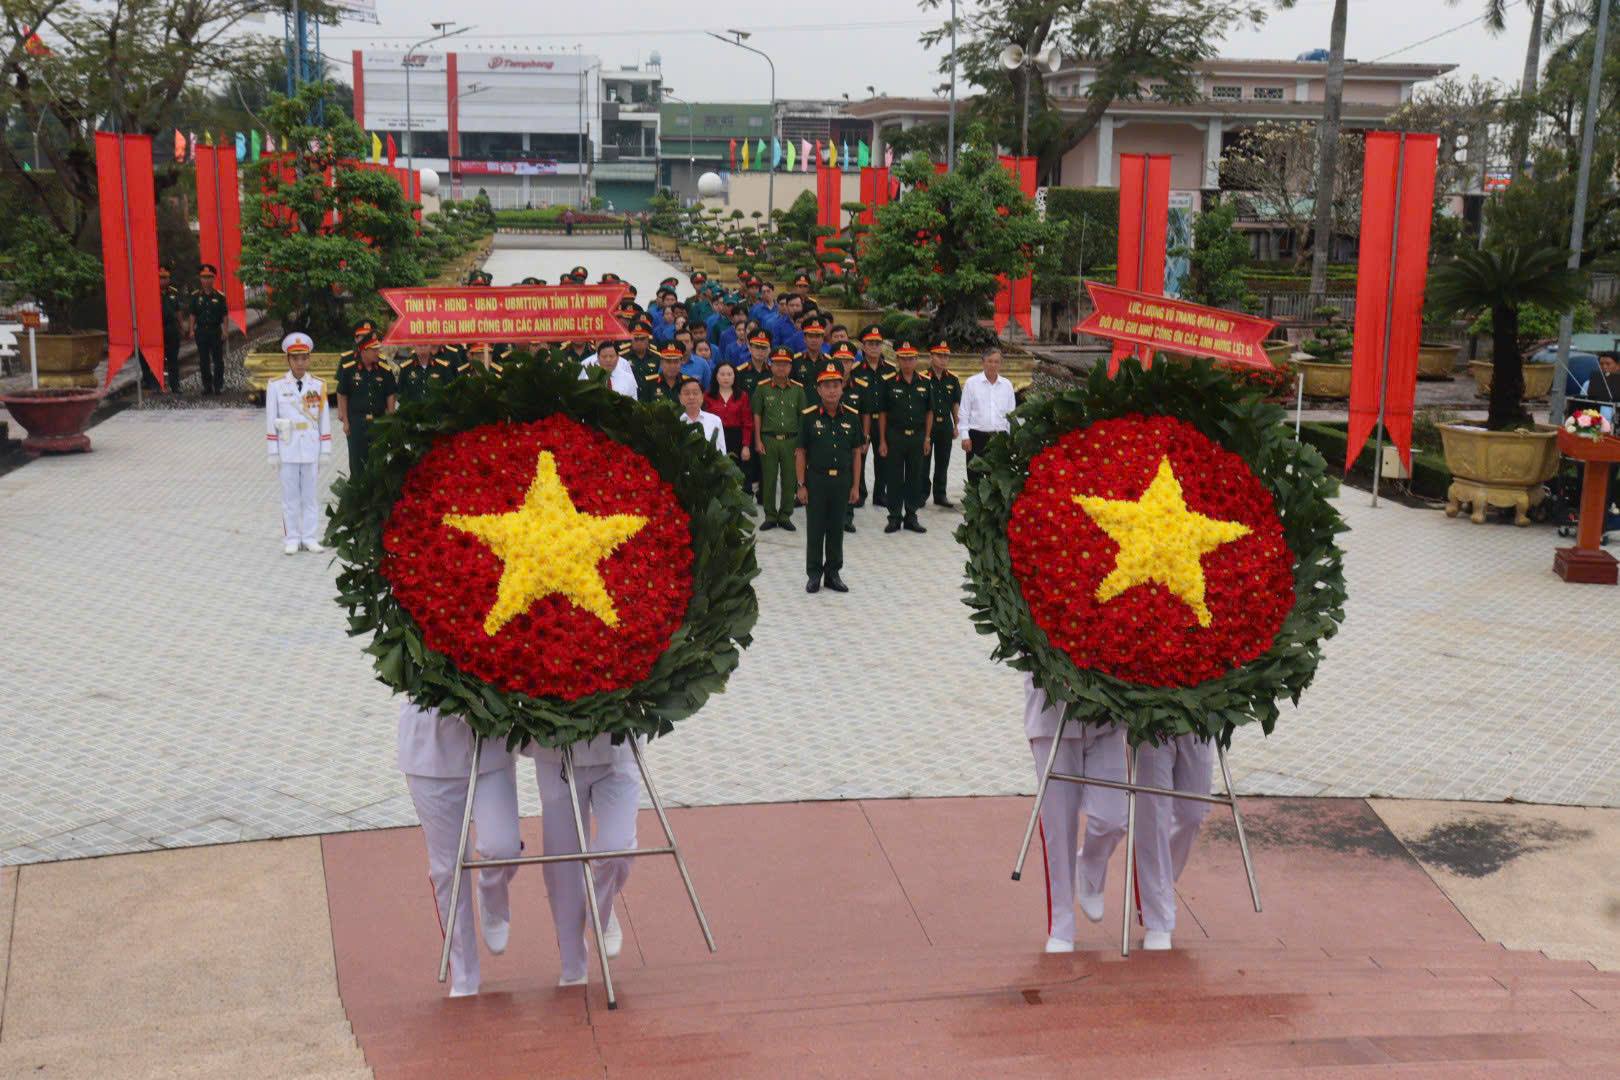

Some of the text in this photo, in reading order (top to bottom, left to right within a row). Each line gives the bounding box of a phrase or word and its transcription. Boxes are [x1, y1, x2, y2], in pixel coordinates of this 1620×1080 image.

[405, 295, 424, 312] TỈNH
[550, 291, 568, 309] TỈNH
[570, 293, 585, 309] TÂY
[587, 295, 607, 309] NINH
[442, 319, 457, 334] GHI
[458, 316, 476, 334] NHỚ
[478, 316, 500, 333] CÔNG
[515, 315, 532, 332] CÁC
[534, 317, 551, 332] ANH
[553, 314, 575, 332] HÙNG
[577, 315, 593, 333] LIỆT
[1175, 310, 1197, 326] TRANG
[1197, 314, 1216, 331] QUÂN
[1215, 318, 1230, 333] KHU
[1125, 320, 1139, 335] GHI
[1154, 324, 1173, 342] CÔNG
[1184, 331, 1199, 347] CÁC
[1198, 335, 1214, 350] ANH
[1213, 335, 1232, 353] HÙNG
